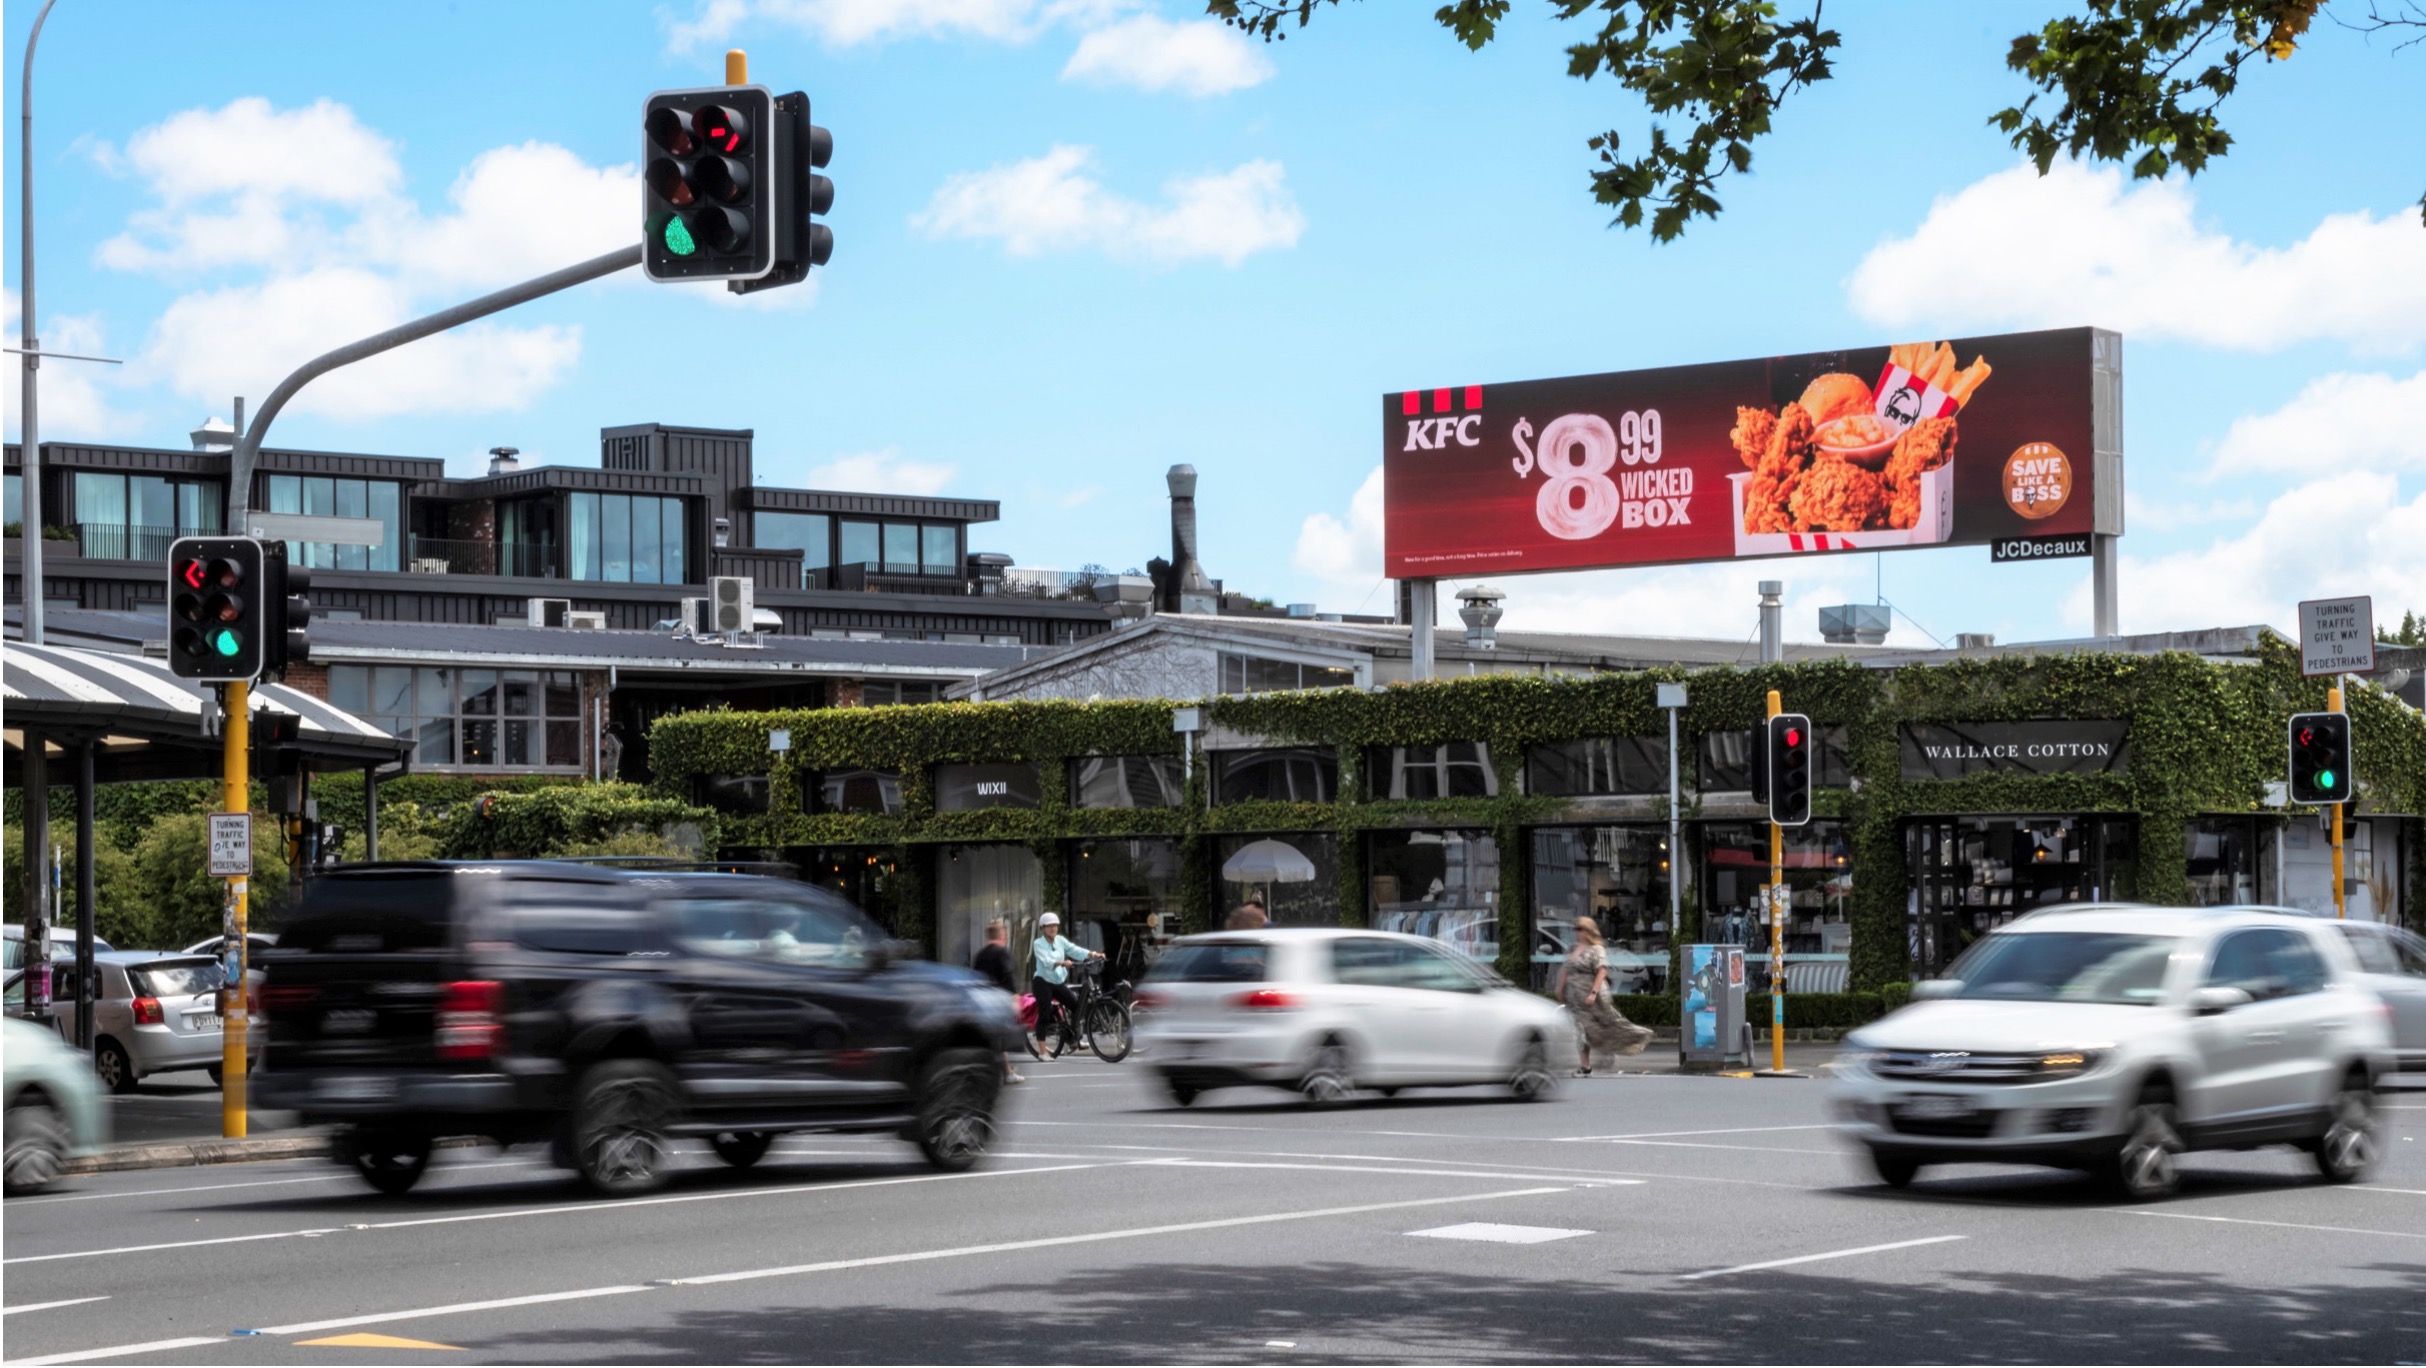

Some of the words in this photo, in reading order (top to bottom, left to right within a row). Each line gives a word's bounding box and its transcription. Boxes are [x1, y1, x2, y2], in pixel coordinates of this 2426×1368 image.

[1403, 414, 1482, 451] KFC
[2012, 457, 2062, 476] SAVE
[1620, 467, 1693, 500] WICKED
[2017, 476, 2043, 486] LIKE
[2047, 475, 2055, 484] A
[1622, 497, 1692, 529] BOX
[1996, 540, 2086, 558] JCDecaux
[2315, 604, 2355, 616] TURNING
[2316, 617, 2355, 629] TRAFFIC
[2314, 632, 2335, 643] GIVE
[2341, 629, 2358, 640] WAY
[2332, 644, 2343, 655] TO
[2308, 656, 2368, 669] PEDESTRIANS
[1925, 744, 2019, 758] WALLACE
[2028, 743, 2110, 757] COTTON
[977, 782, 1006, 795] WIXII
[216, 820, 244, 829] TURNING
[216, 831, 244, 839] TRAFFIC
[233, 841, 245, 849] WAY
[226, 851, 235, 859] TO
